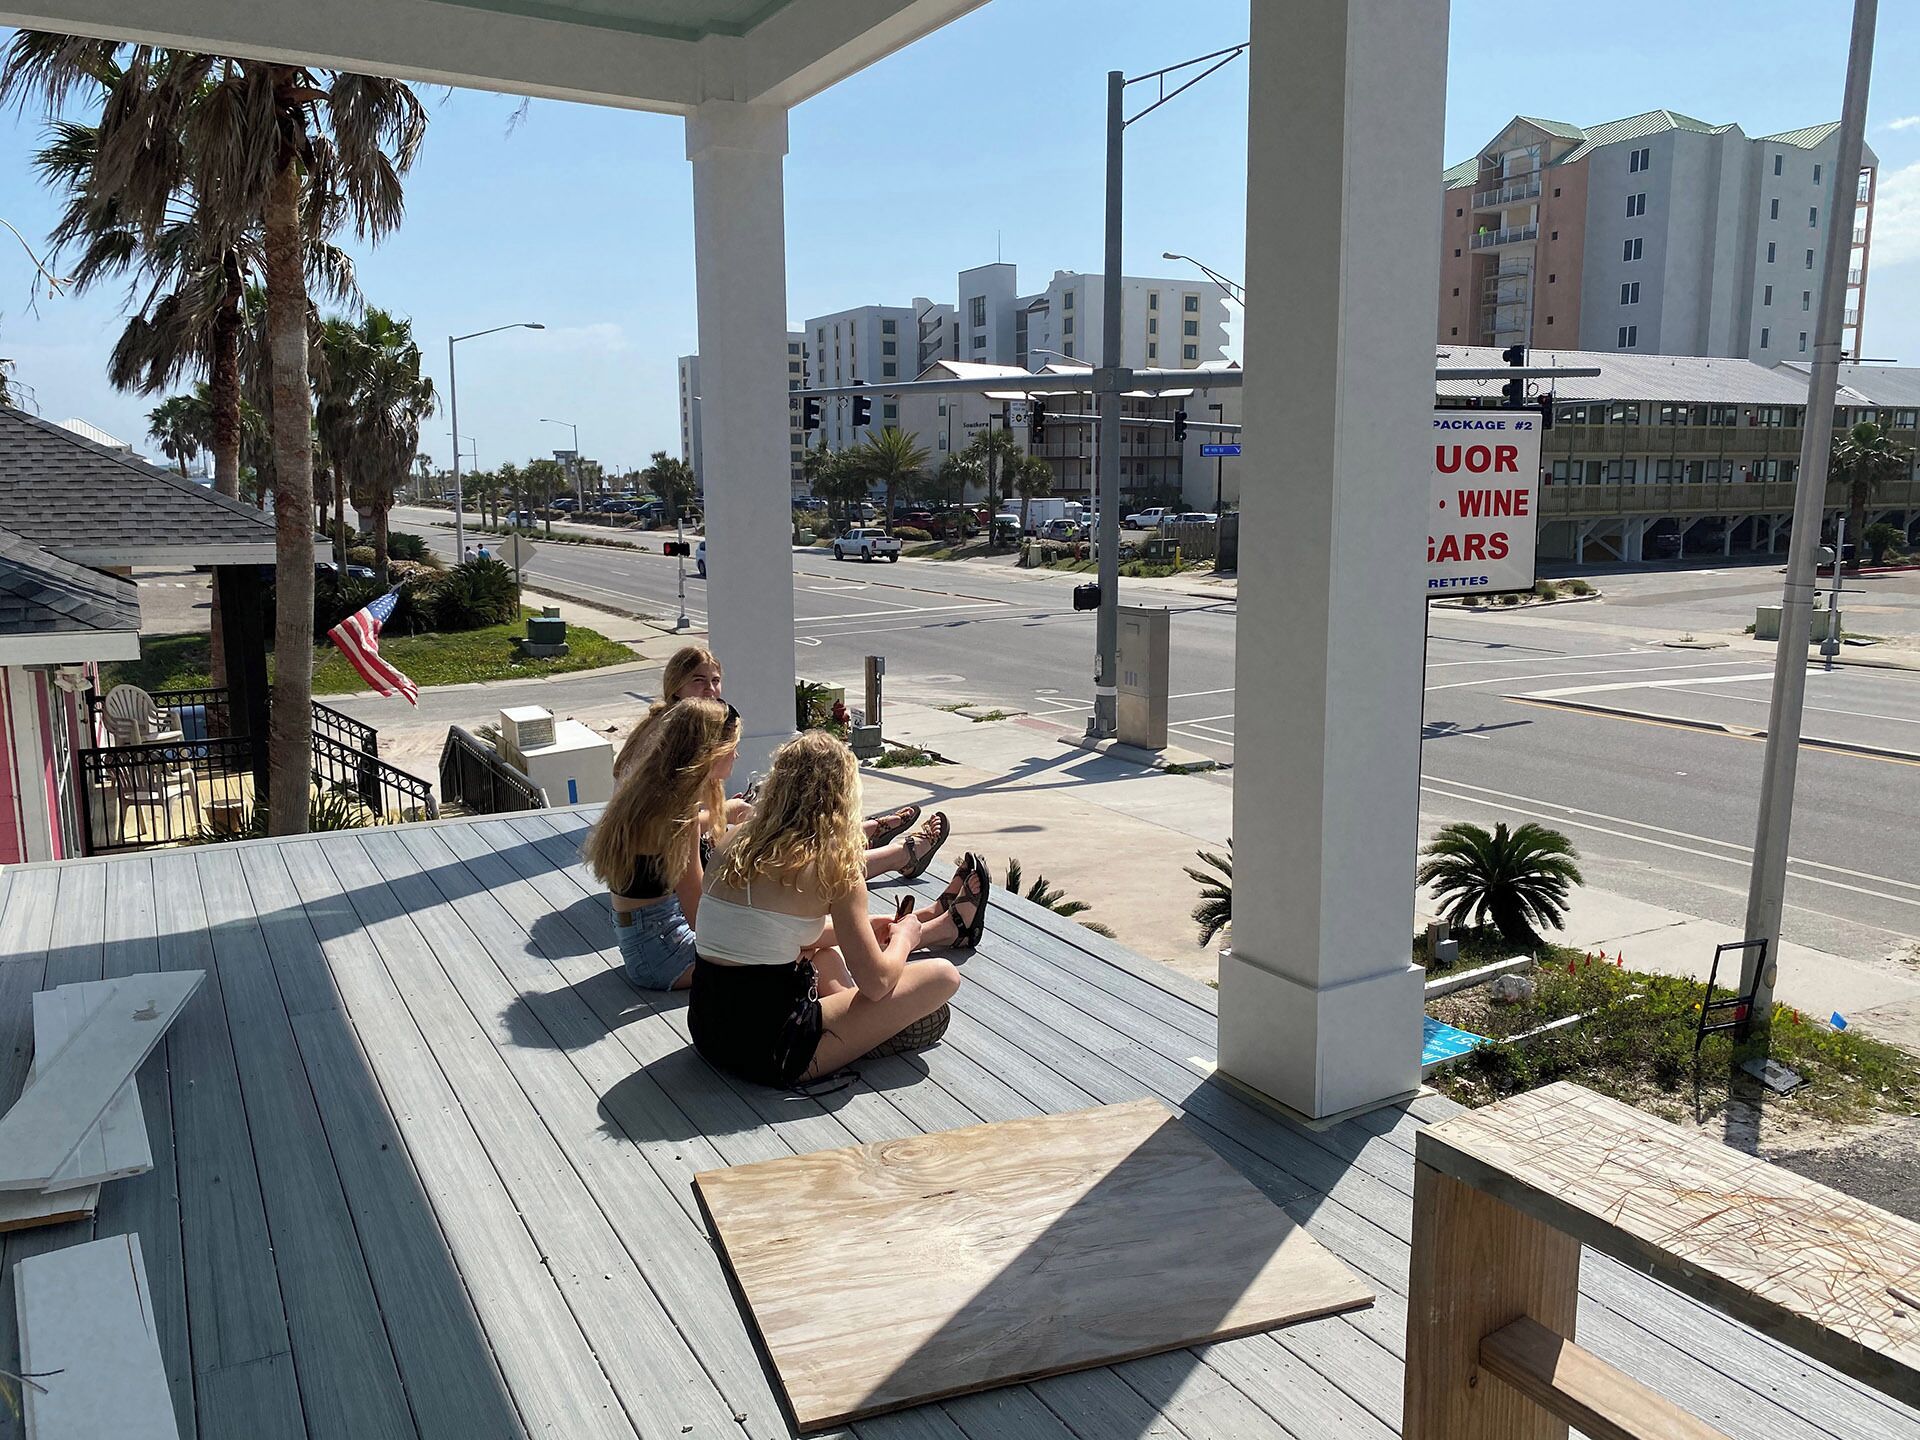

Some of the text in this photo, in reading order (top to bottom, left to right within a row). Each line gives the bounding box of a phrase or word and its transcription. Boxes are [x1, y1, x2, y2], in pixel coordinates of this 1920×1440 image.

[1433, 420, 1533, 430] PACKAGE #2
[1436, 445, 1519, 473] UOR
[1458, 489, 1529, 518] WINE
[1428, 575, 1489, 588] RETTES
